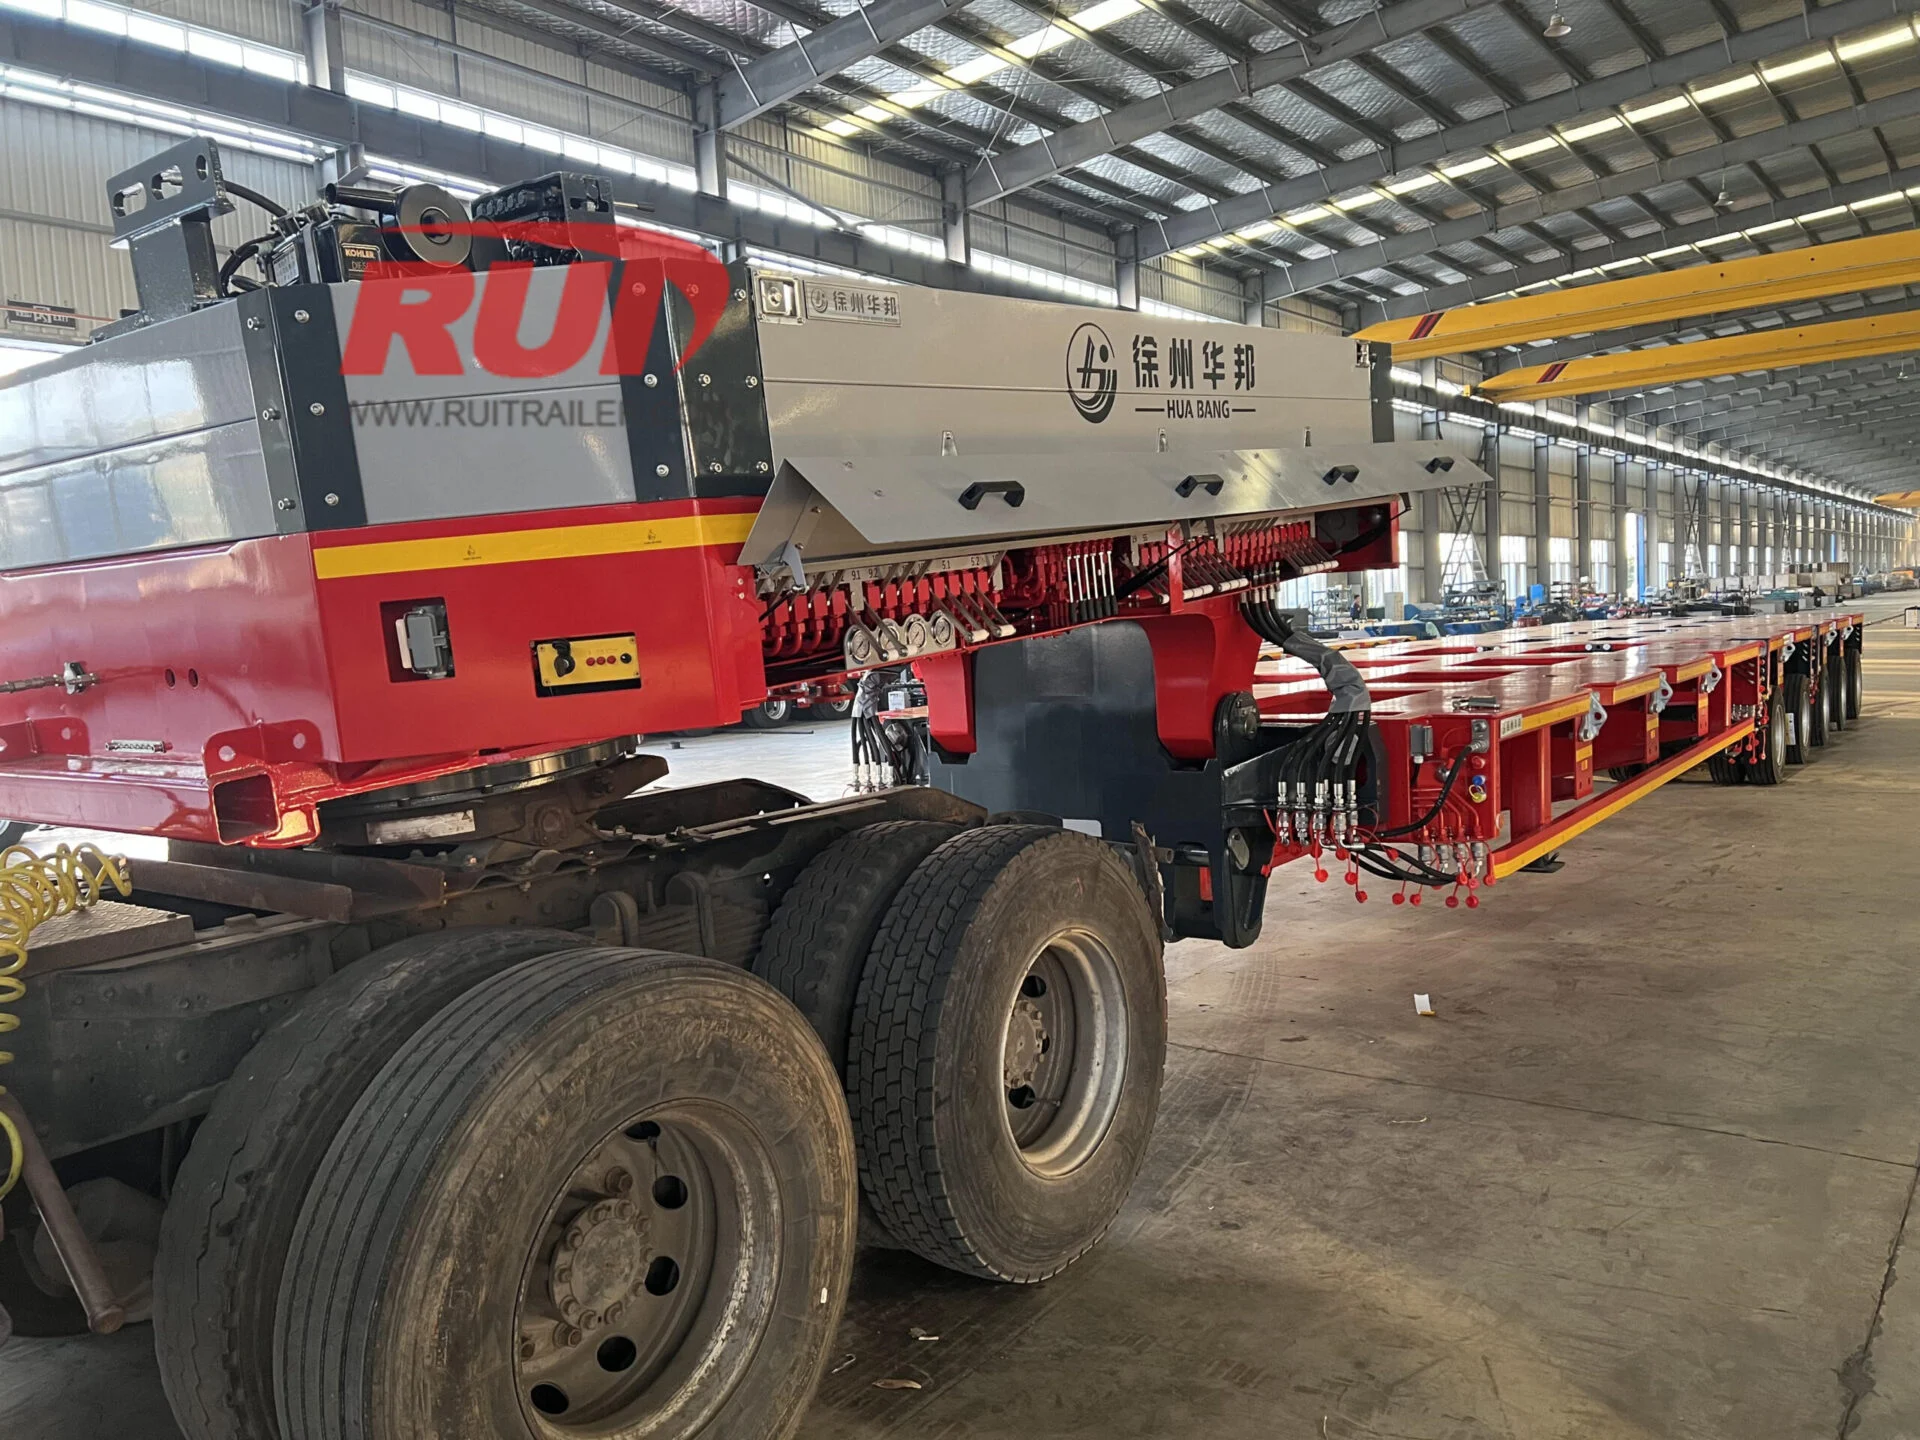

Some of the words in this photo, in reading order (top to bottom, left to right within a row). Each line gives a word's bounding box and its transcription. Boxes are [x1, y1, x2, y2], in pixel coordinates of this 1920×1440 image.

[345, 248, 375, 258] KOHLER
[833, 290, 897, 317] 徐州华邦
[1133, 334, 1255, 391] 徐州华邦
[1167, 399, 1194, 419] HUA
[1197, 400, 1230, 420] BANG
